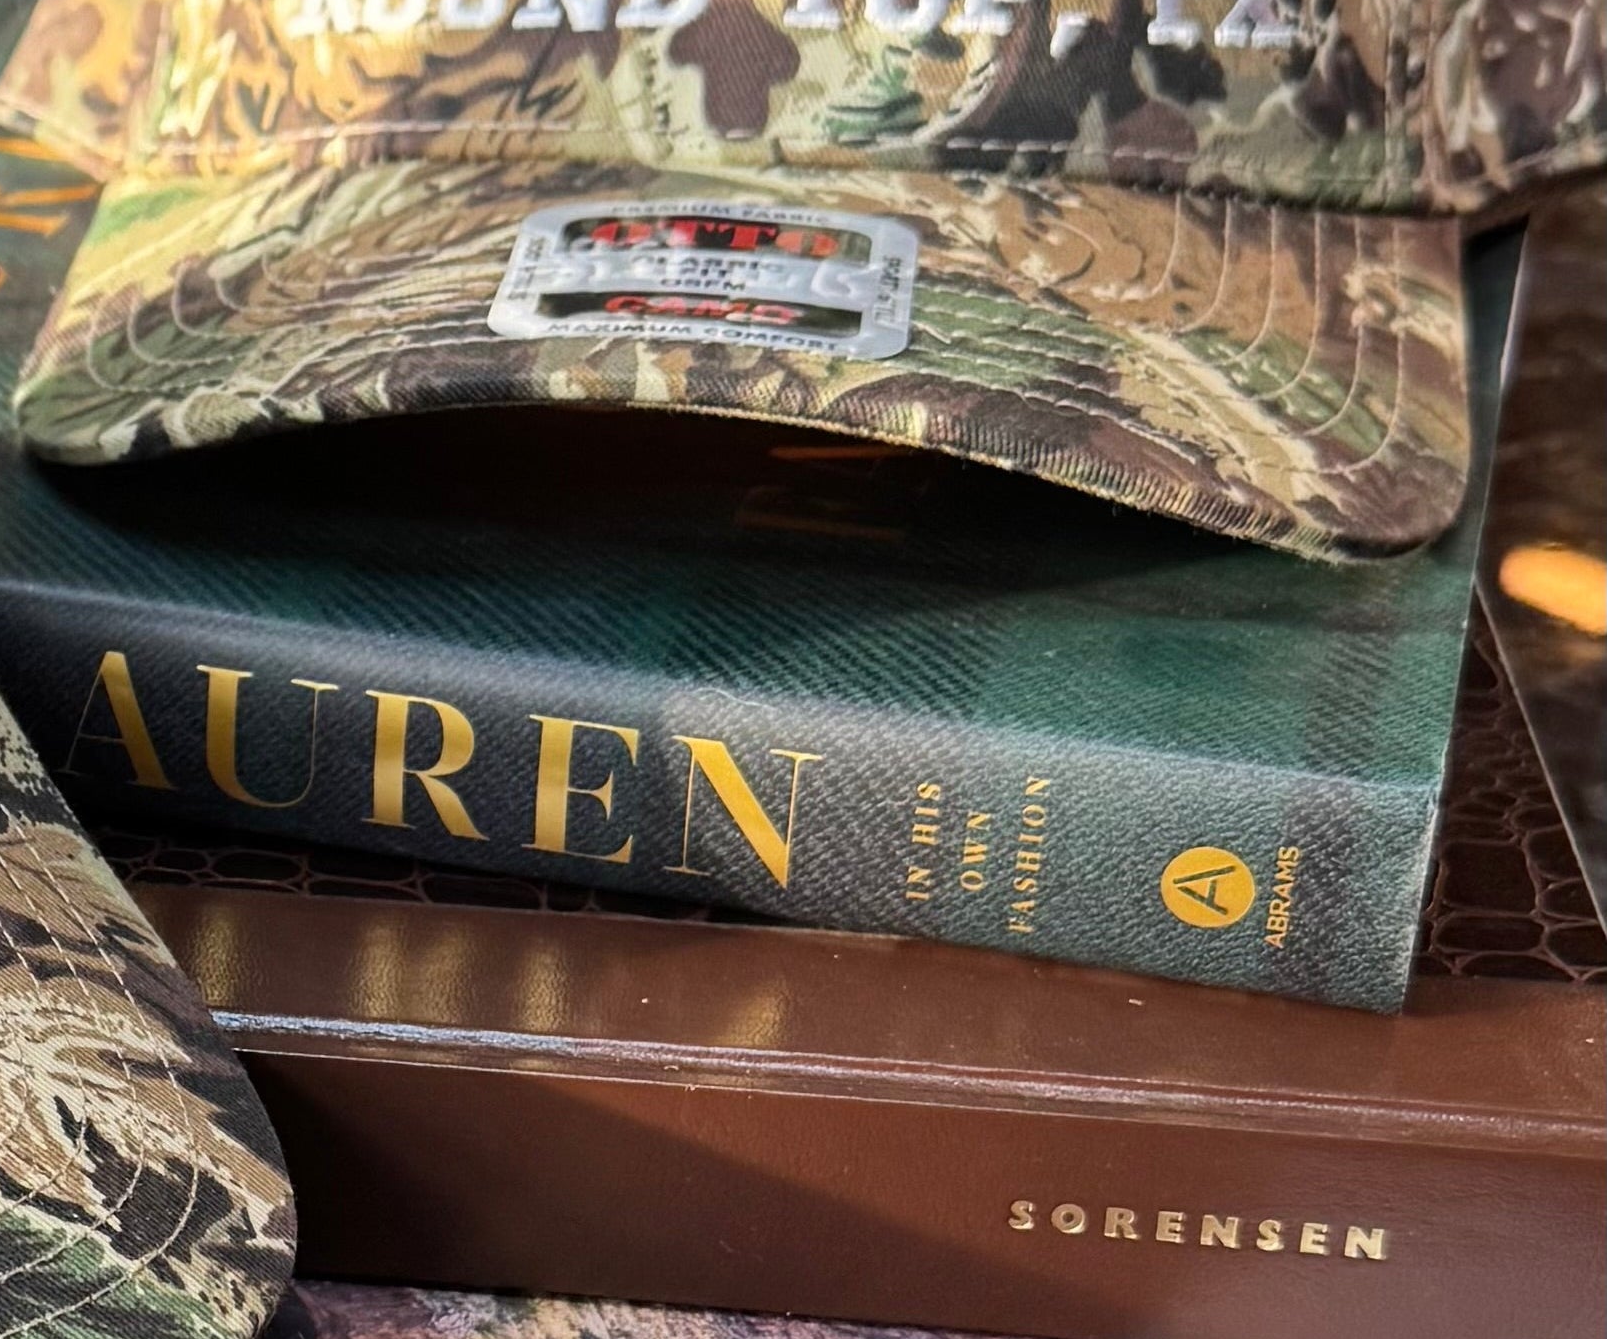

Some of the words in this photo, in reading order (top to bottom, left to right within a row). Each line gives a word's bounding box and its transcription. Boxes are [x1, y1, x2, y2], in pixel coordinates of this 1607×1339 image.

[44, 650, 824, 890] AUREN
[911, 781, 943, 846] HIS
[960, 811, 993, 892] OWN
[906, 864, 933, 901] IN
[1008, 775, 1051, 934] FASHION
[1263, 845, 1300, 950] ABRAMS
[1007, 1199, 1387, 1261] SORENSEN
